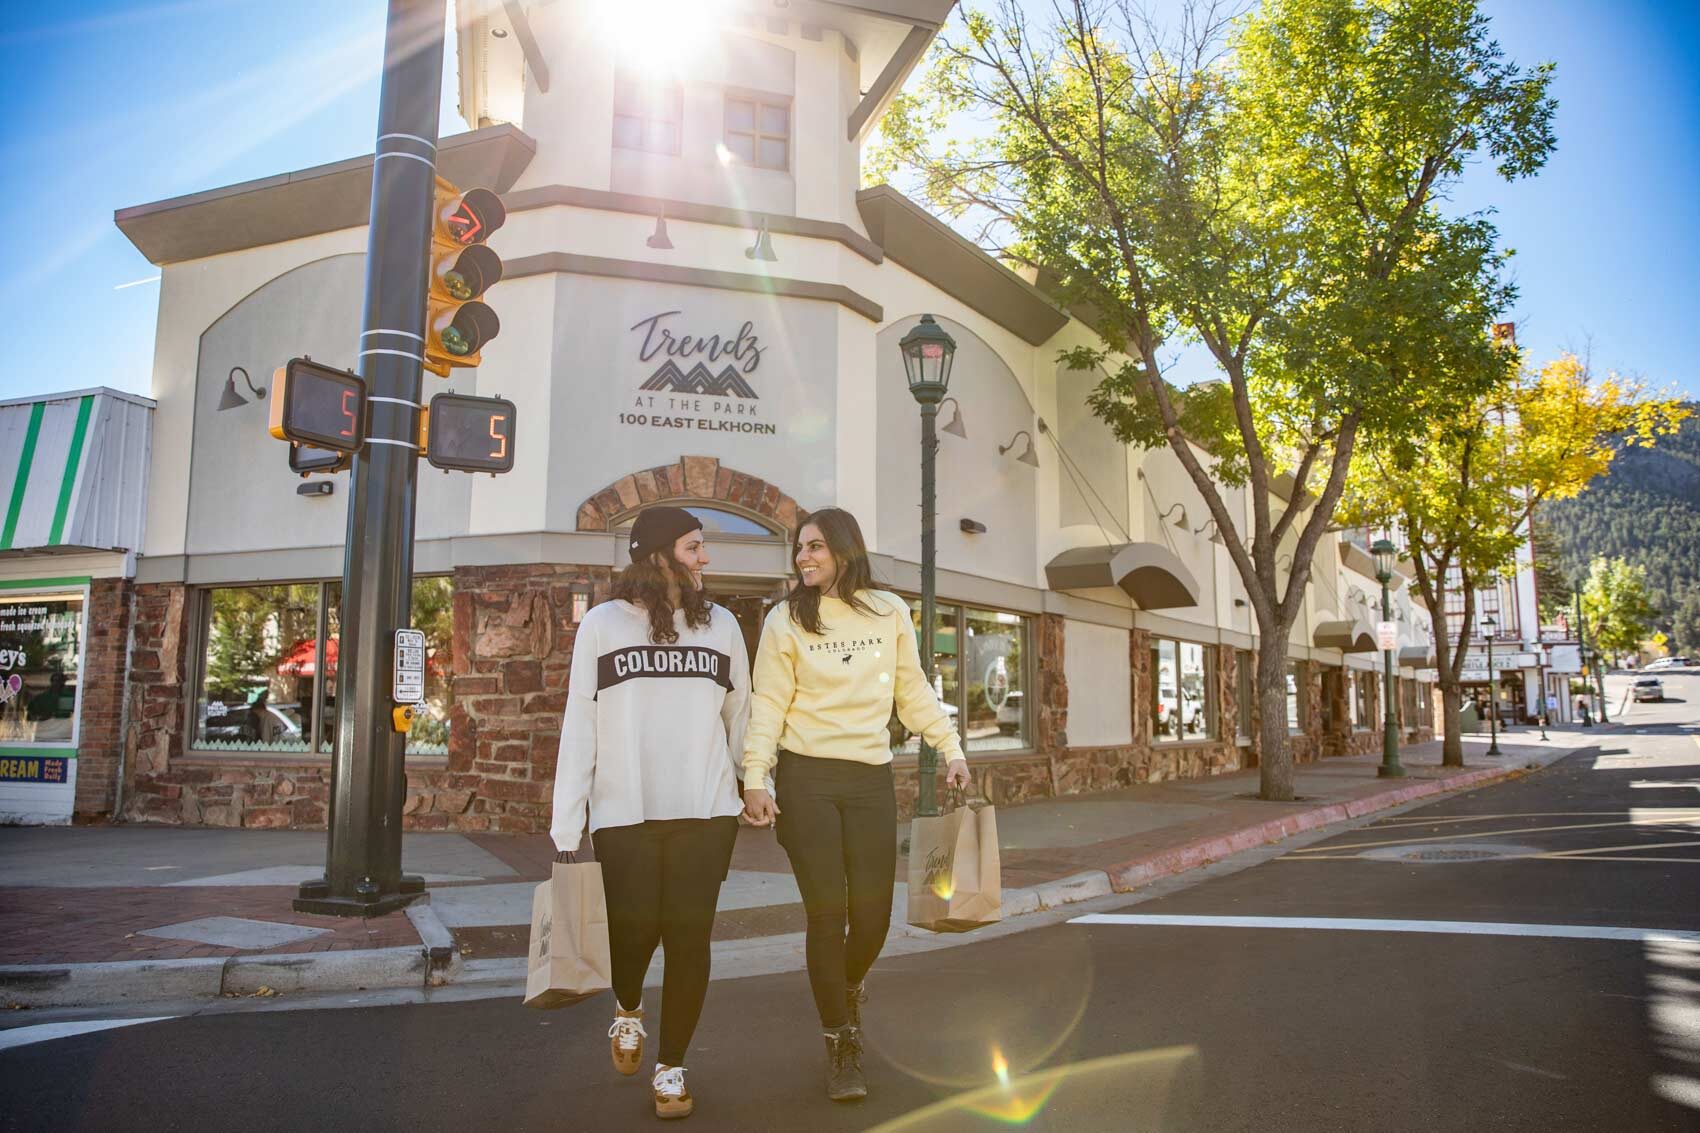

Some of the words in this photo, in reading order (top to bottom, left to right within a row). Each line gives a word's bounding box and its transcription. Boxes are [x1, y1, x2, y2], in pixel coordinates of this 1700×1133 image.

[630, 311, 768, 373] Trendz
[341, 390, 356, 437] 5
[635, 397, 654, 408] AT
[670, 399, 701, 412] THE
[714, 402, 757, 416] PARK
[489, 415, 506, 458] 5
[619, 413, 647, 425] 100
[651, 416, 694, 429] EAST
[698, 419, 776, 434] ELKHORN
[810, 641, 846, 652] ESTES
[852, 637, 883, 647] PARK
[614, 650, 718, 677] COLORADO
